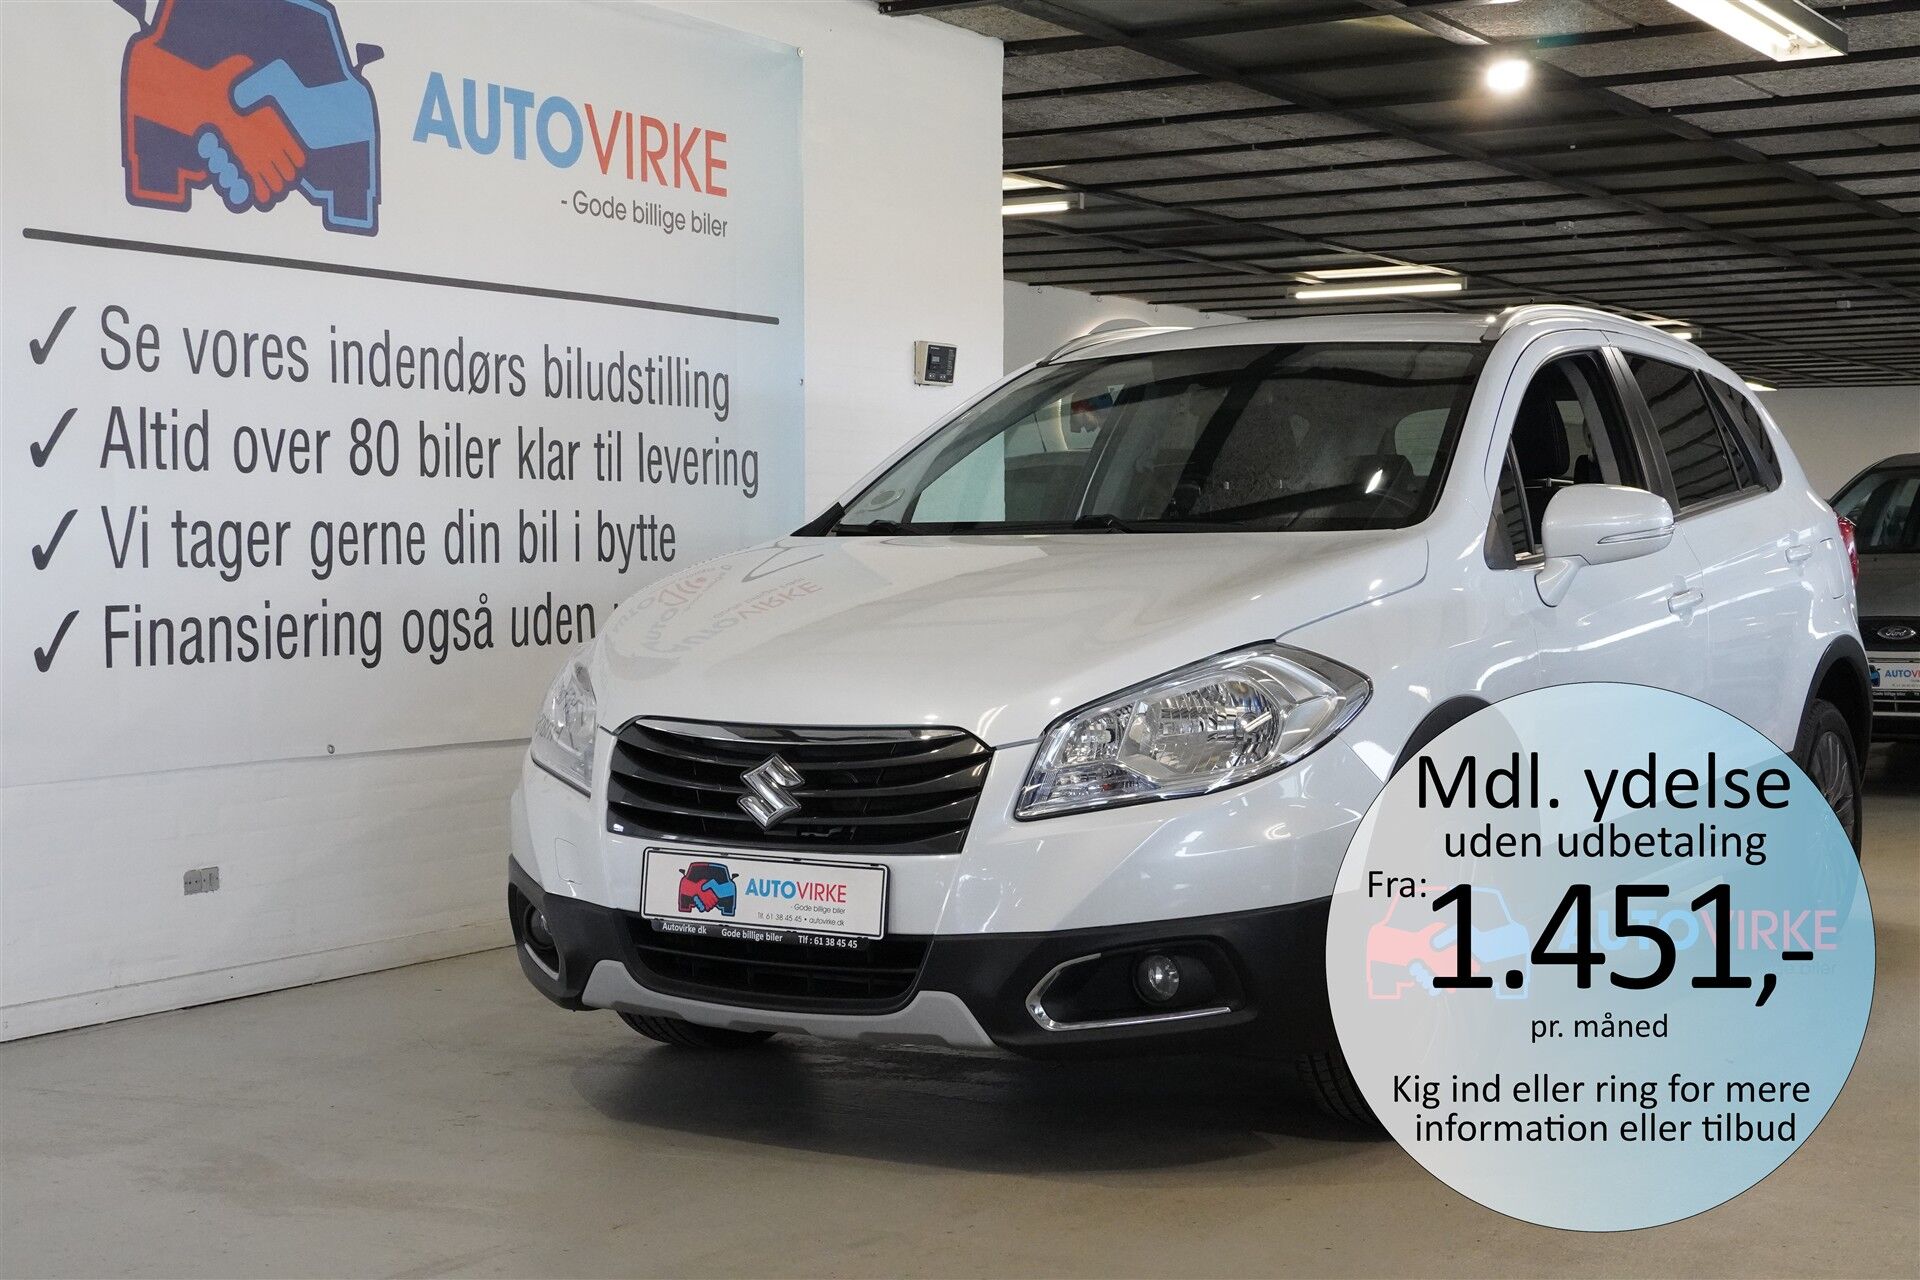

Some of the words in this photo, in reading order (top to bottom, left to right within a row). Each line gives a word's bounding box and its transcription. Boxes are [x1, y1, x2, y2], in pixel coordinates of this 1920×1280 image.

[412, 71, 728, 198] AUTOVIRKE
[573, 190, 627, 221] Gode
[632, 200, 686, 234] billige
[691, 210, 728, 237] biler
[100, 305, 161, 374] Se
[183, 327, 310, 384] vores
[330, 325, 527, 398] indendørs
[544, 344, 730, 423] biludstilling
[100, 406, 210, 474] Altid
[233, 425, 332, 477] over
[349, 417, 400, 479] 80
[419, 420, 501, 481] biler
[517, 426, 580, 482] klar
[594, 431, 624, 483] til
[638, 431, 760, 500] levering
[102, 505, 151, 571] Vi
[172, 511, 292, 584] tager
[310, 520, 427, 583] gerne
[444, 508, 501, 567] din
[519, 508, 559, 566] bil
[574, 509, 582, 564] i
[597, 509, 677, 576] bytte
[104, 599, 384, 671] Finansiering
[402, 593, 495, 668] også
[511, 592, 596, 649] uden
[745, 878, 847, 904] AUTOVIRKE
[721, 928, 741, 938] Gode
[742, 930, 764, 941] billige
[765, 932, 783, 942] biler
[814, 936, 823, 946] 61
[825, 937, 835, 947] 38
[836, 938, 846, 948] 45
[847, 939, 858, 949] 45
